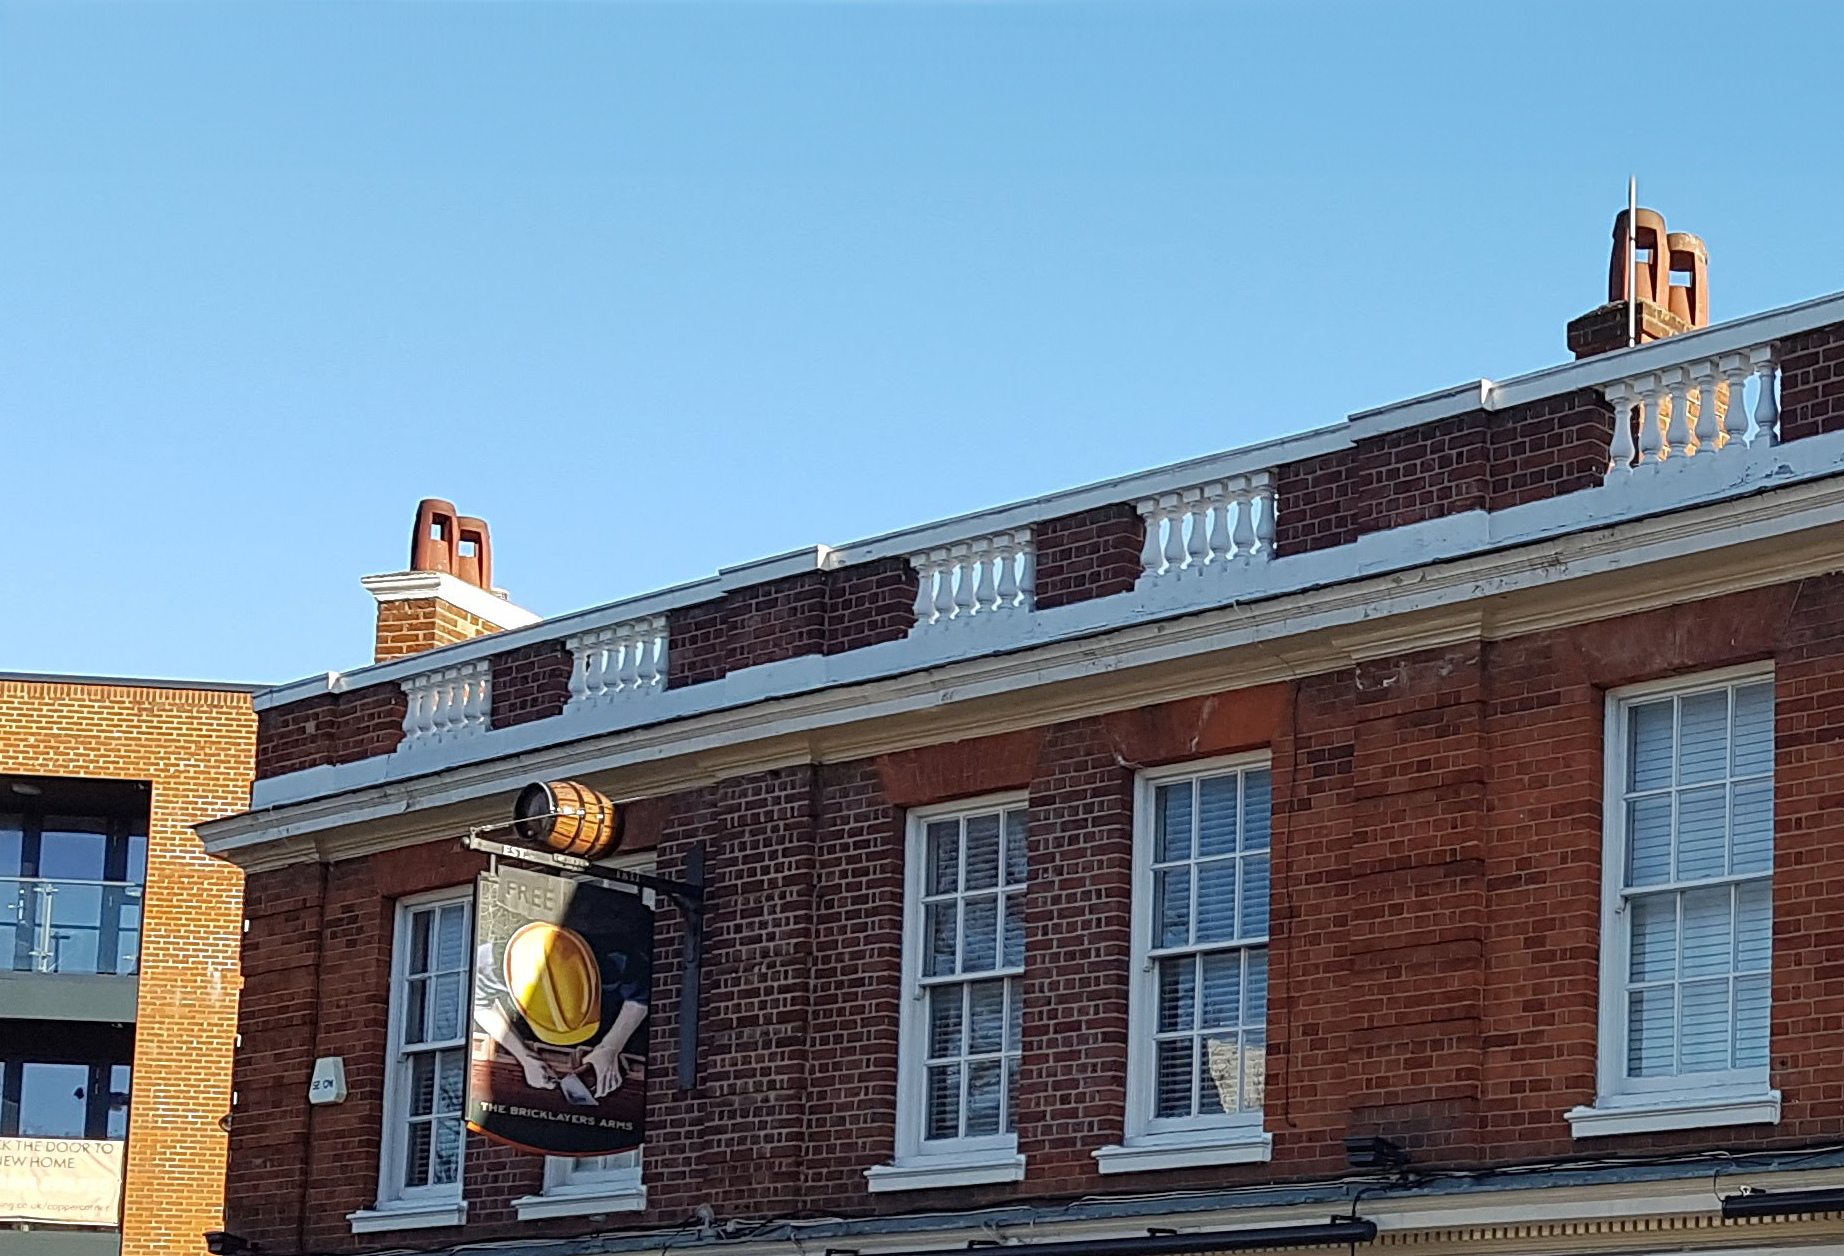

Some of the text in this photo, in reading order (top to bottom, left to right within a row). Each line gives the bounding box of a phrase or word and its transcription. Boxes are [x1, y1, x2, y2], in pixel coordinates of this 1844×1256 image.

[507, 881, 553, 911] FREE
[480, 1101, 633, 1131] THE BRICKLAYERS ARMS
[16, 1140, 42, 1152] THE
[46, 1142, 90, 1153] DOOR
[95, 1143, 114, 1154] TO
[30, 1157, 76, 1168] HOME
